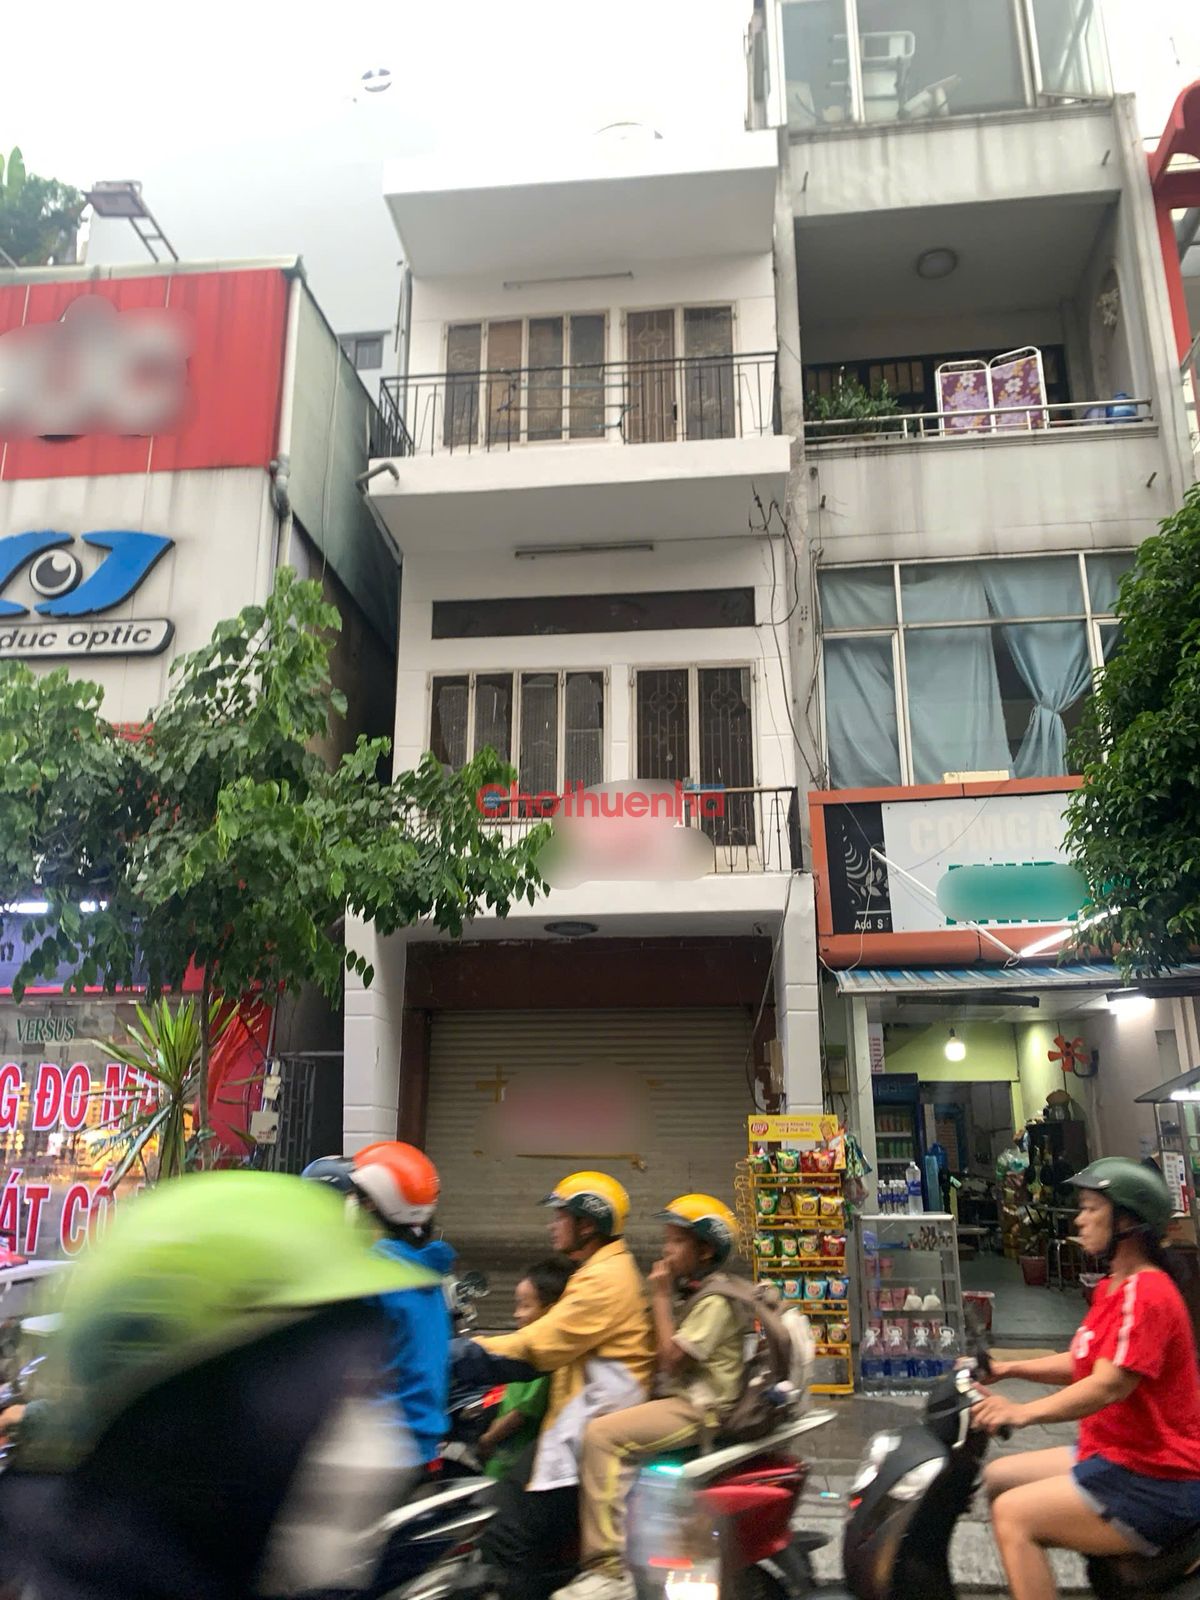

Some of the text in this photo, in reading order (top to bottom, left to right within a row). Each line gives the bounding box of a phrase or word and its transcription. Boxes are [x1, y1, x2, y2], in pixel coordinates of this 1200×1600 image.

[0, 624, 151, 651] duc optic
[854, 919, 872, 930] Add
[16, 1016, 75, 1043] VERSUS
[33, 1063, 91, 1132] ĐO
